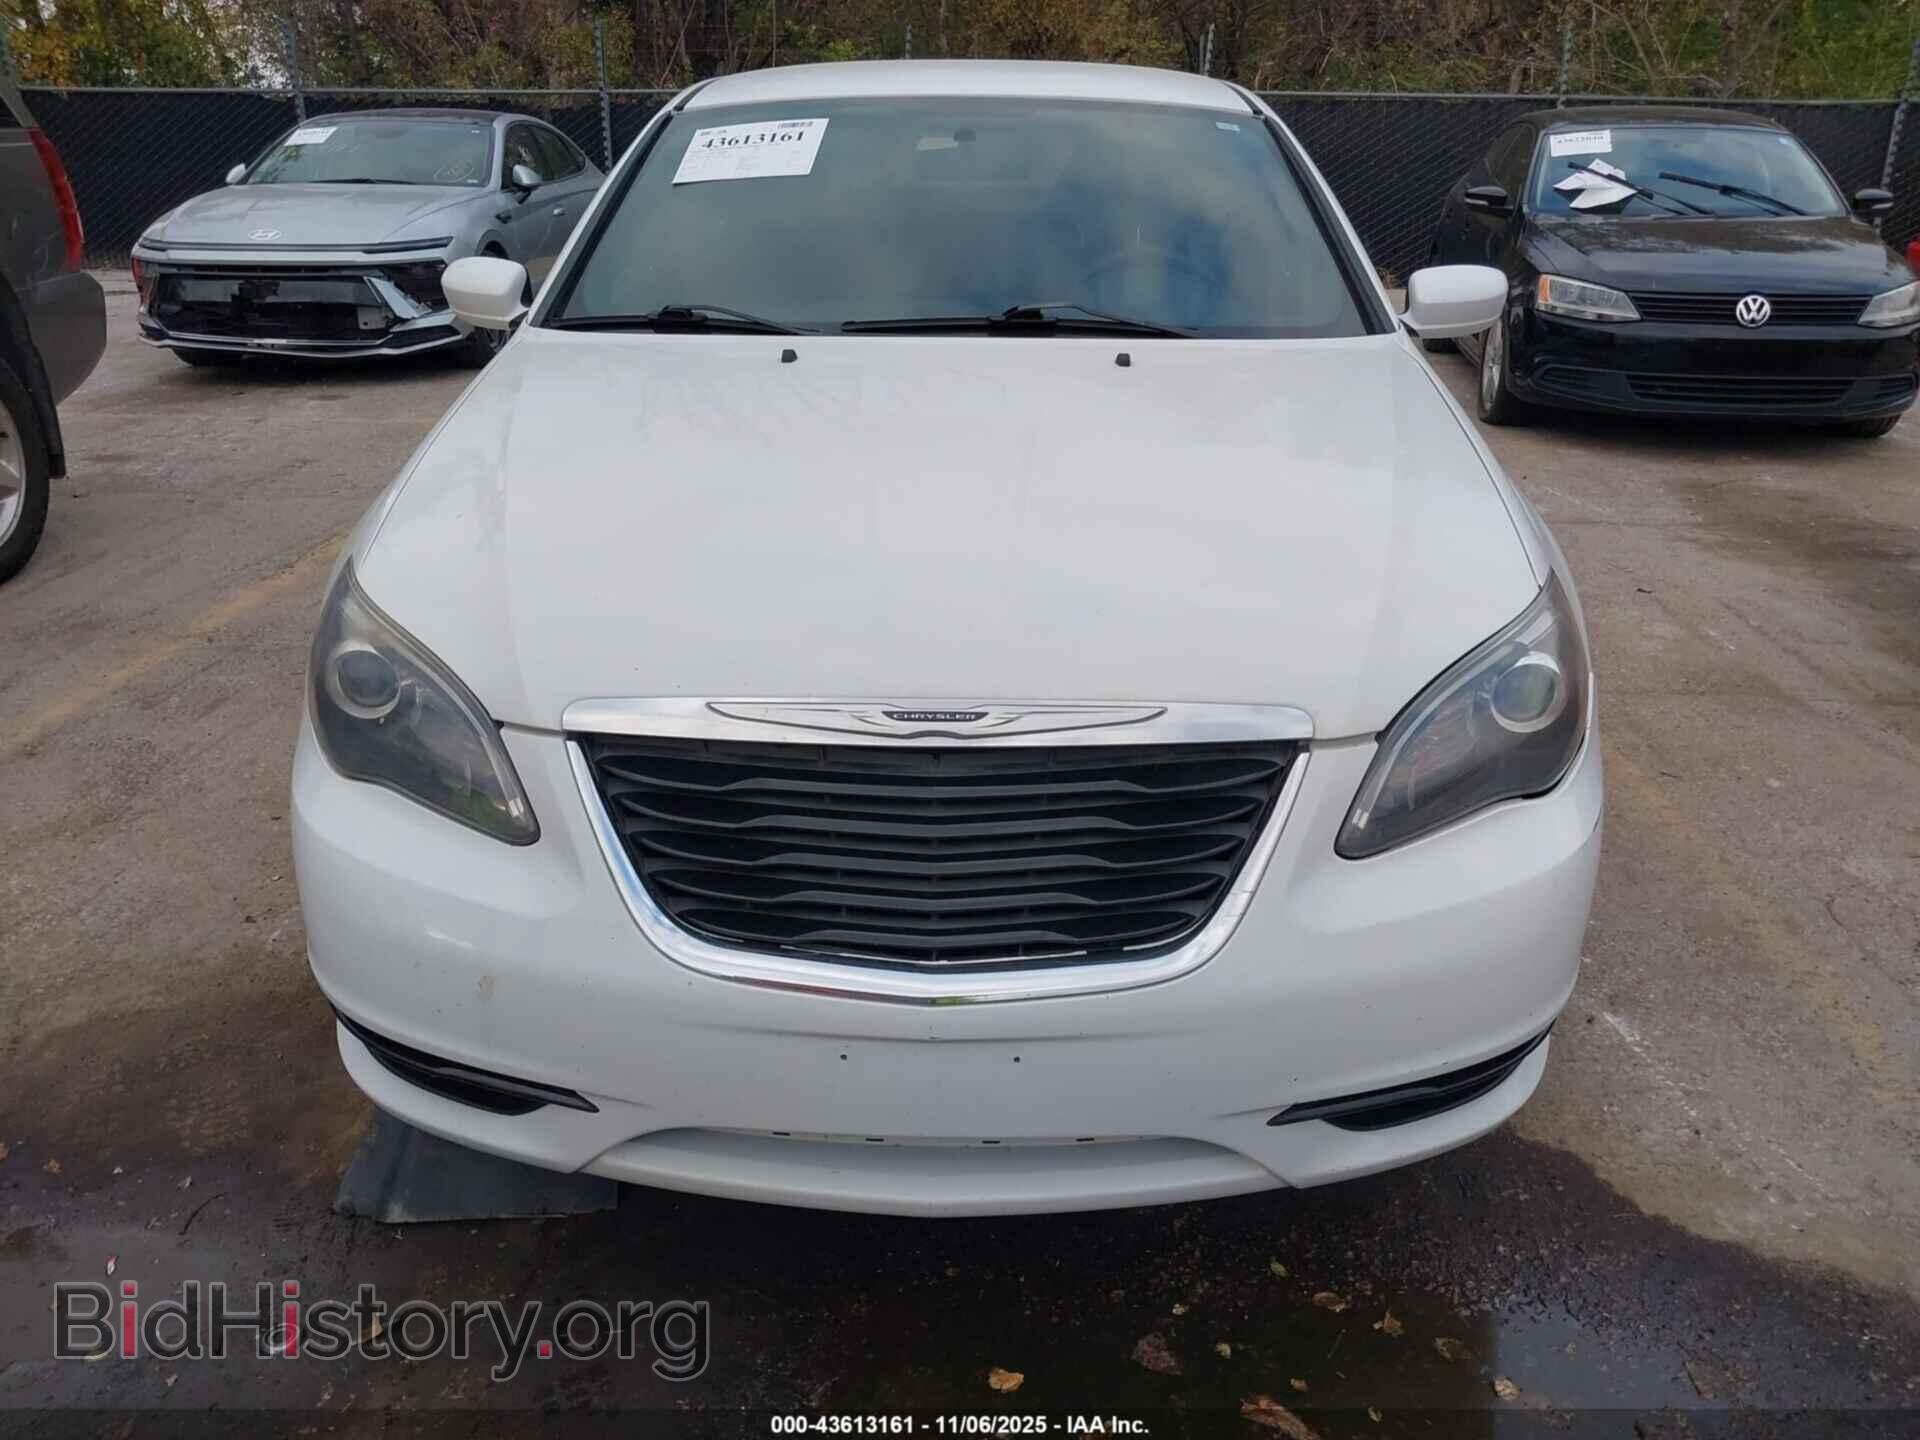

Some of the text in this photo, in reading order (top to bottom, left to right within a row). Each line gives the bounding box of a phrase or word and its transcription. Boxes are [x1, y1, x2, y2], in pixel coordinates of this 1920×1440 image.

[701, 131, 805, 149] 43613161
[1737, 295, 1770, 324] VW
[892, 711, 978, 721] CHRYSLER
